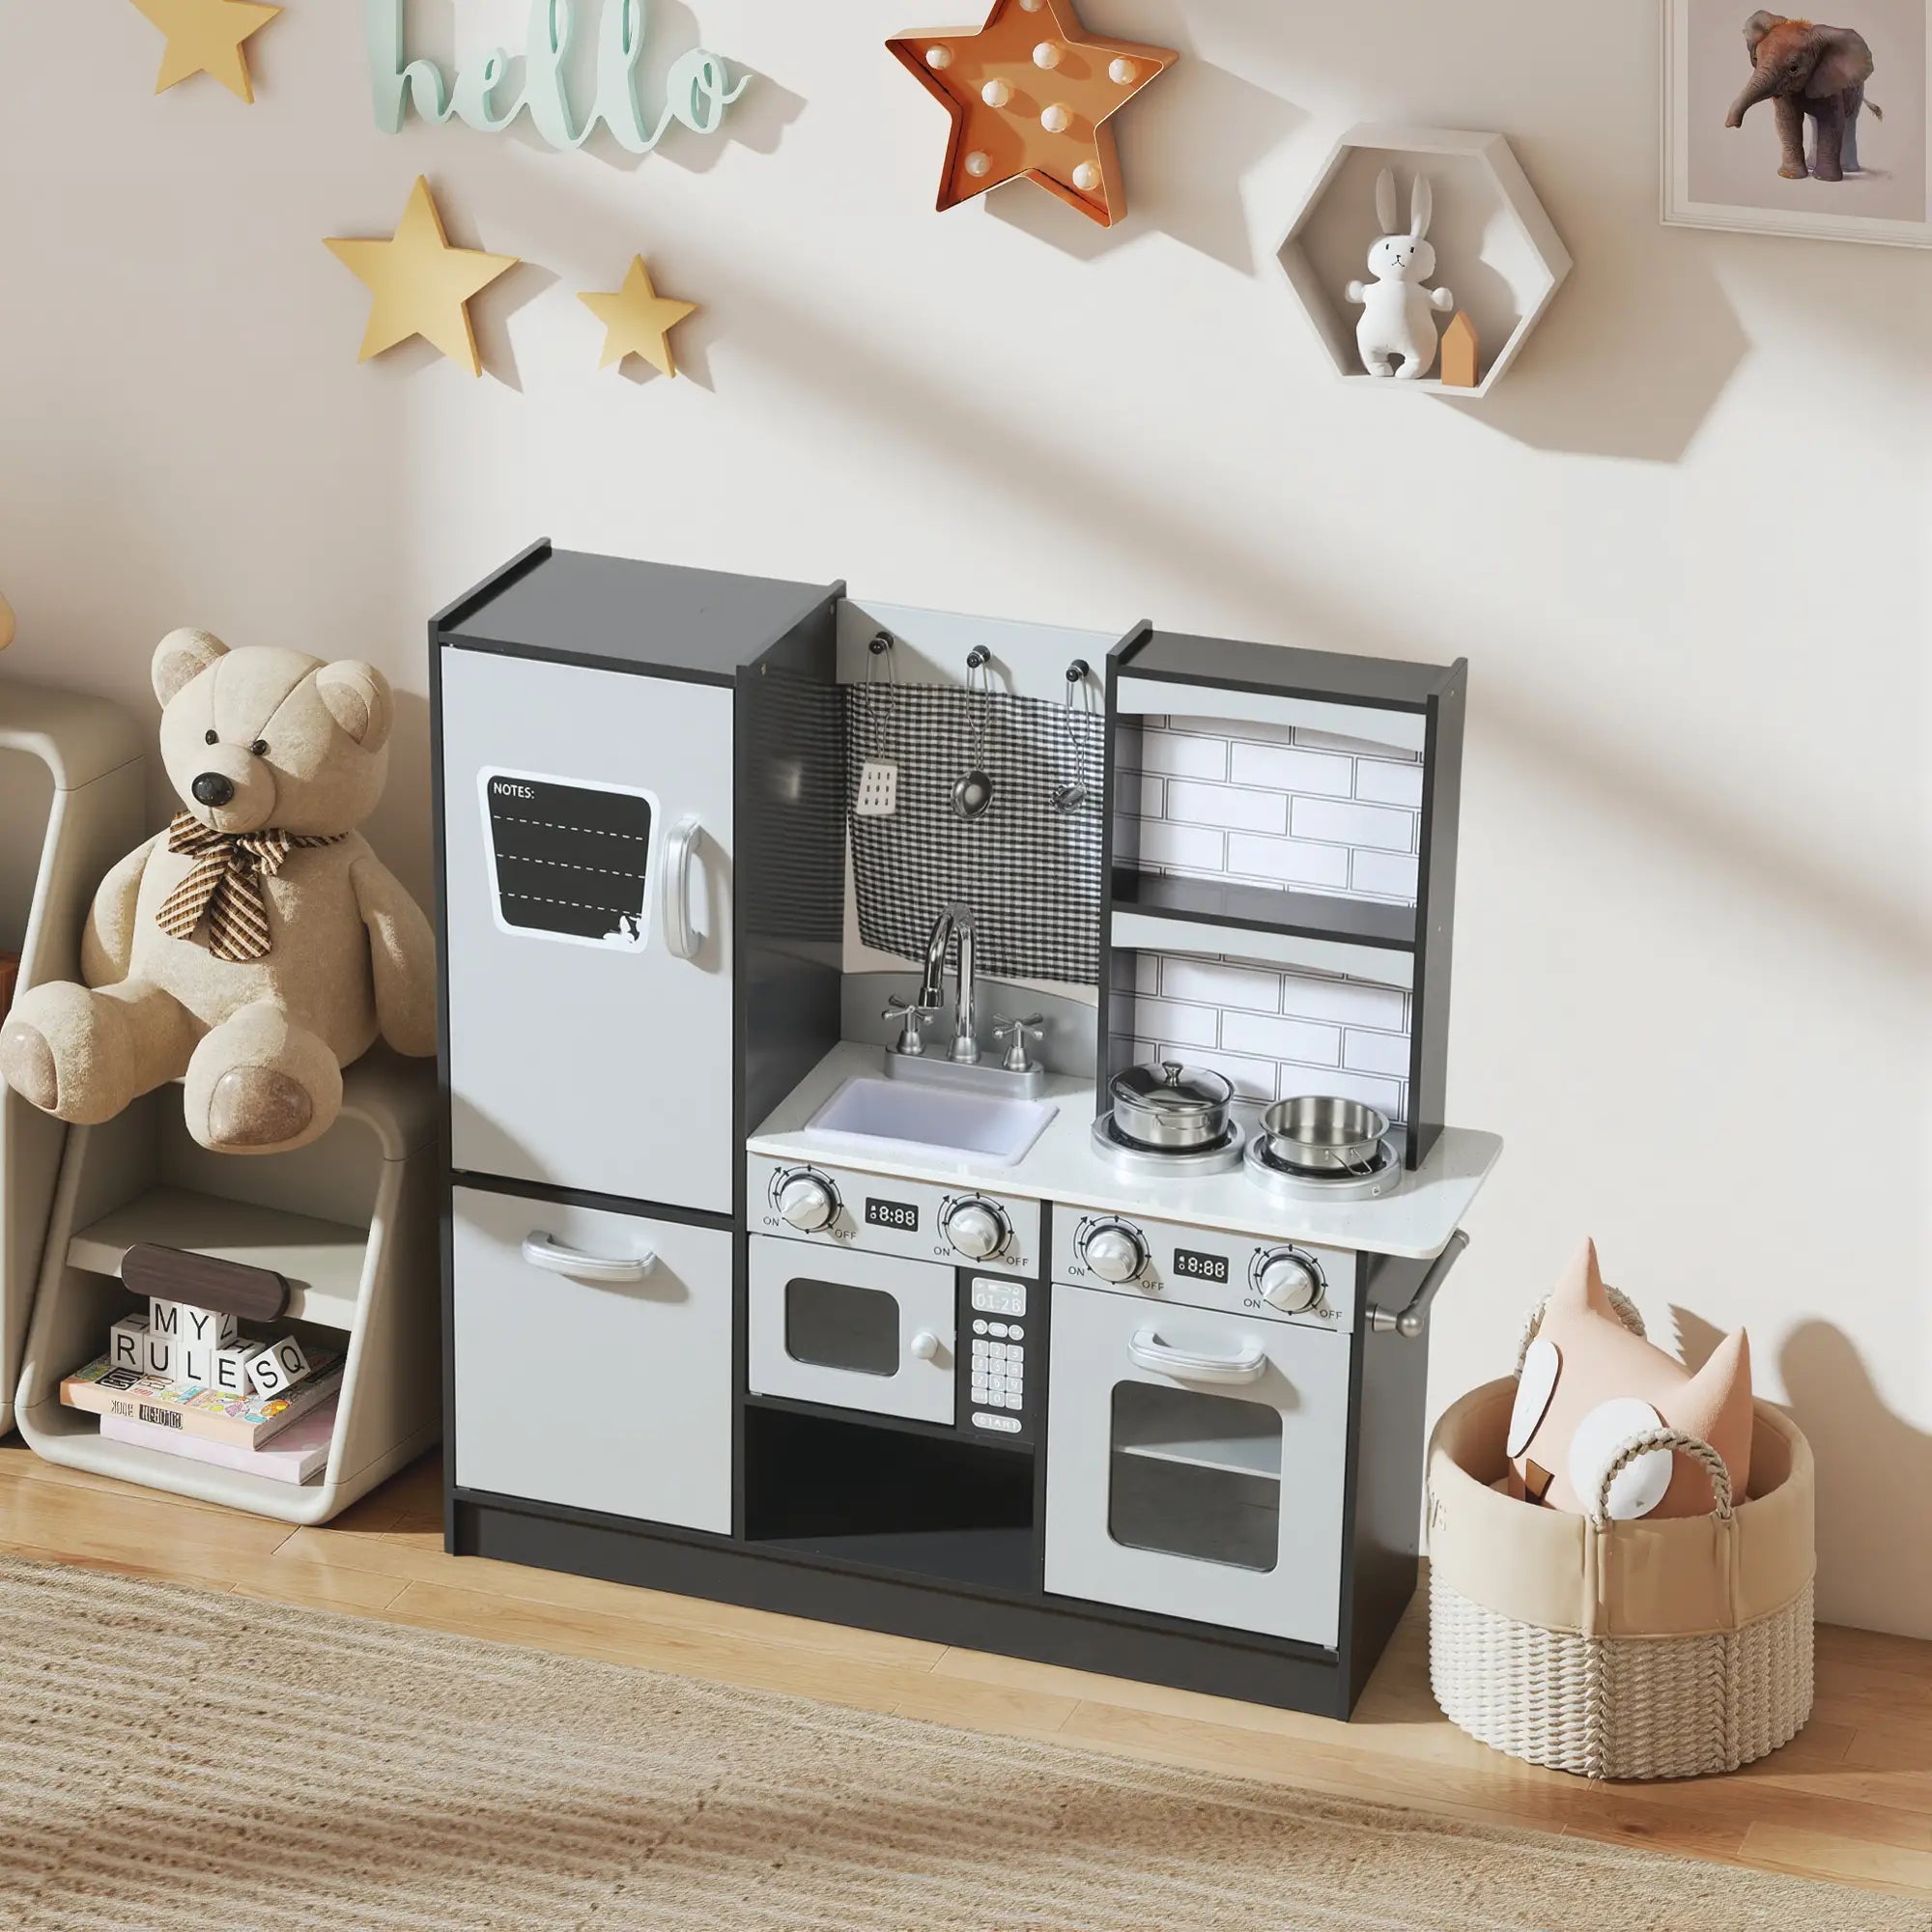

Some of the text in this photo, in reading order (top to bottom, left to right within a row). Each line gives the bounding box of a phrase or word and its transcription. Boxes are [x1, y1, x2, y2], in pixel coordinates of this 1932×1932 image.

[366, 0, 753, 154] hello
[493, 781, 535, 799] NOTES:
[762, 1216, 781, 1227] ON
[834, 1228, 858, 1240] OFF
[933, 1246, 951, 1257] ON
[1006, 1256, 1030, 1267] OFF
[1067, 1264, 1086, 1277] ON
[1142, 1279, 1165, 1292] OFF
[1242, 1297, 1262, 1309] ON
[1319, 1308, 1344, 1321] OFF
[155, 1303, 210, 1341] MY
